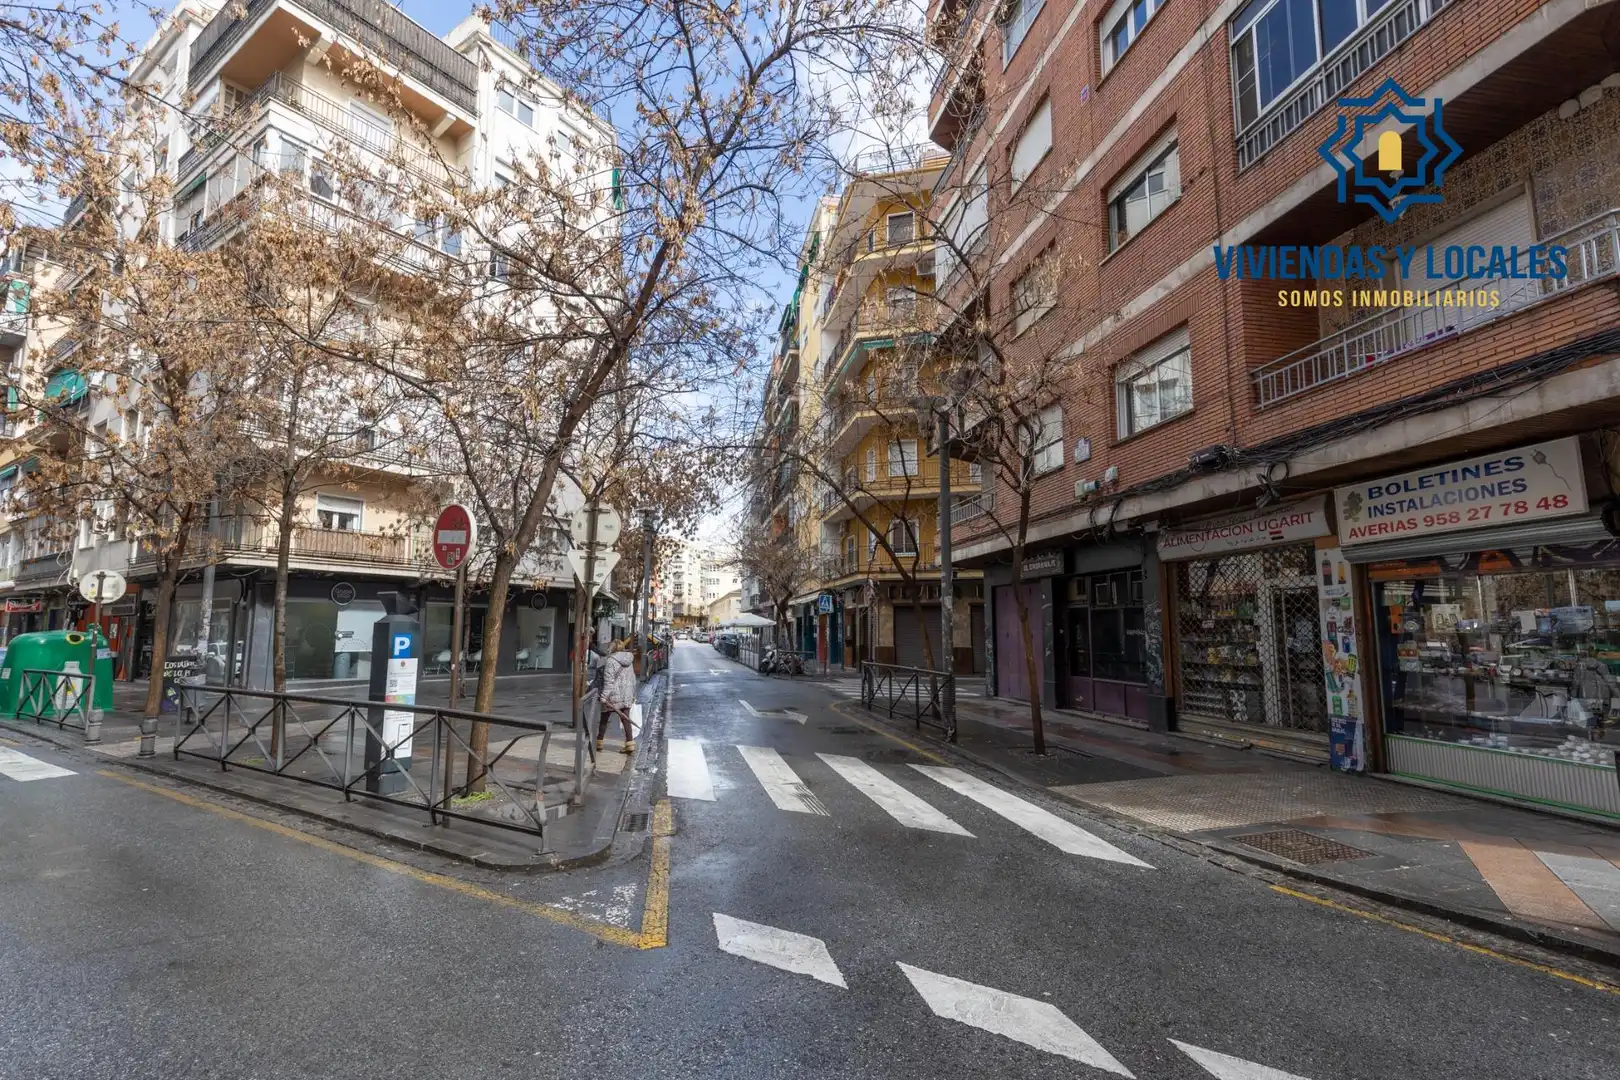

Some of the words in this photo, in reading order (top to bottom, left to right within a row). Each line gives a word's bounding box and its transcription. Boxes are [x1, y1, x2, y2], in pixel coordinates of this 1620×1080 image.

[1367, 456, 1525, 500] BOLETINES
[1367, 478, 1528, 518] INSTALACIONES
[1163, 523, 1253, 549] ALIMENTACION
[1257, 511, 1315, 532] UGARIT
[1348, 518, 1418, 539] AVERIAS
[1423, 511, 1461, 528] 958
[1467, 505, 1492, 521] 27
[1500, 500, 1529, 516] 78
[1536, 494, 1569, 511] 48
[394, 636, 410, 656] P
